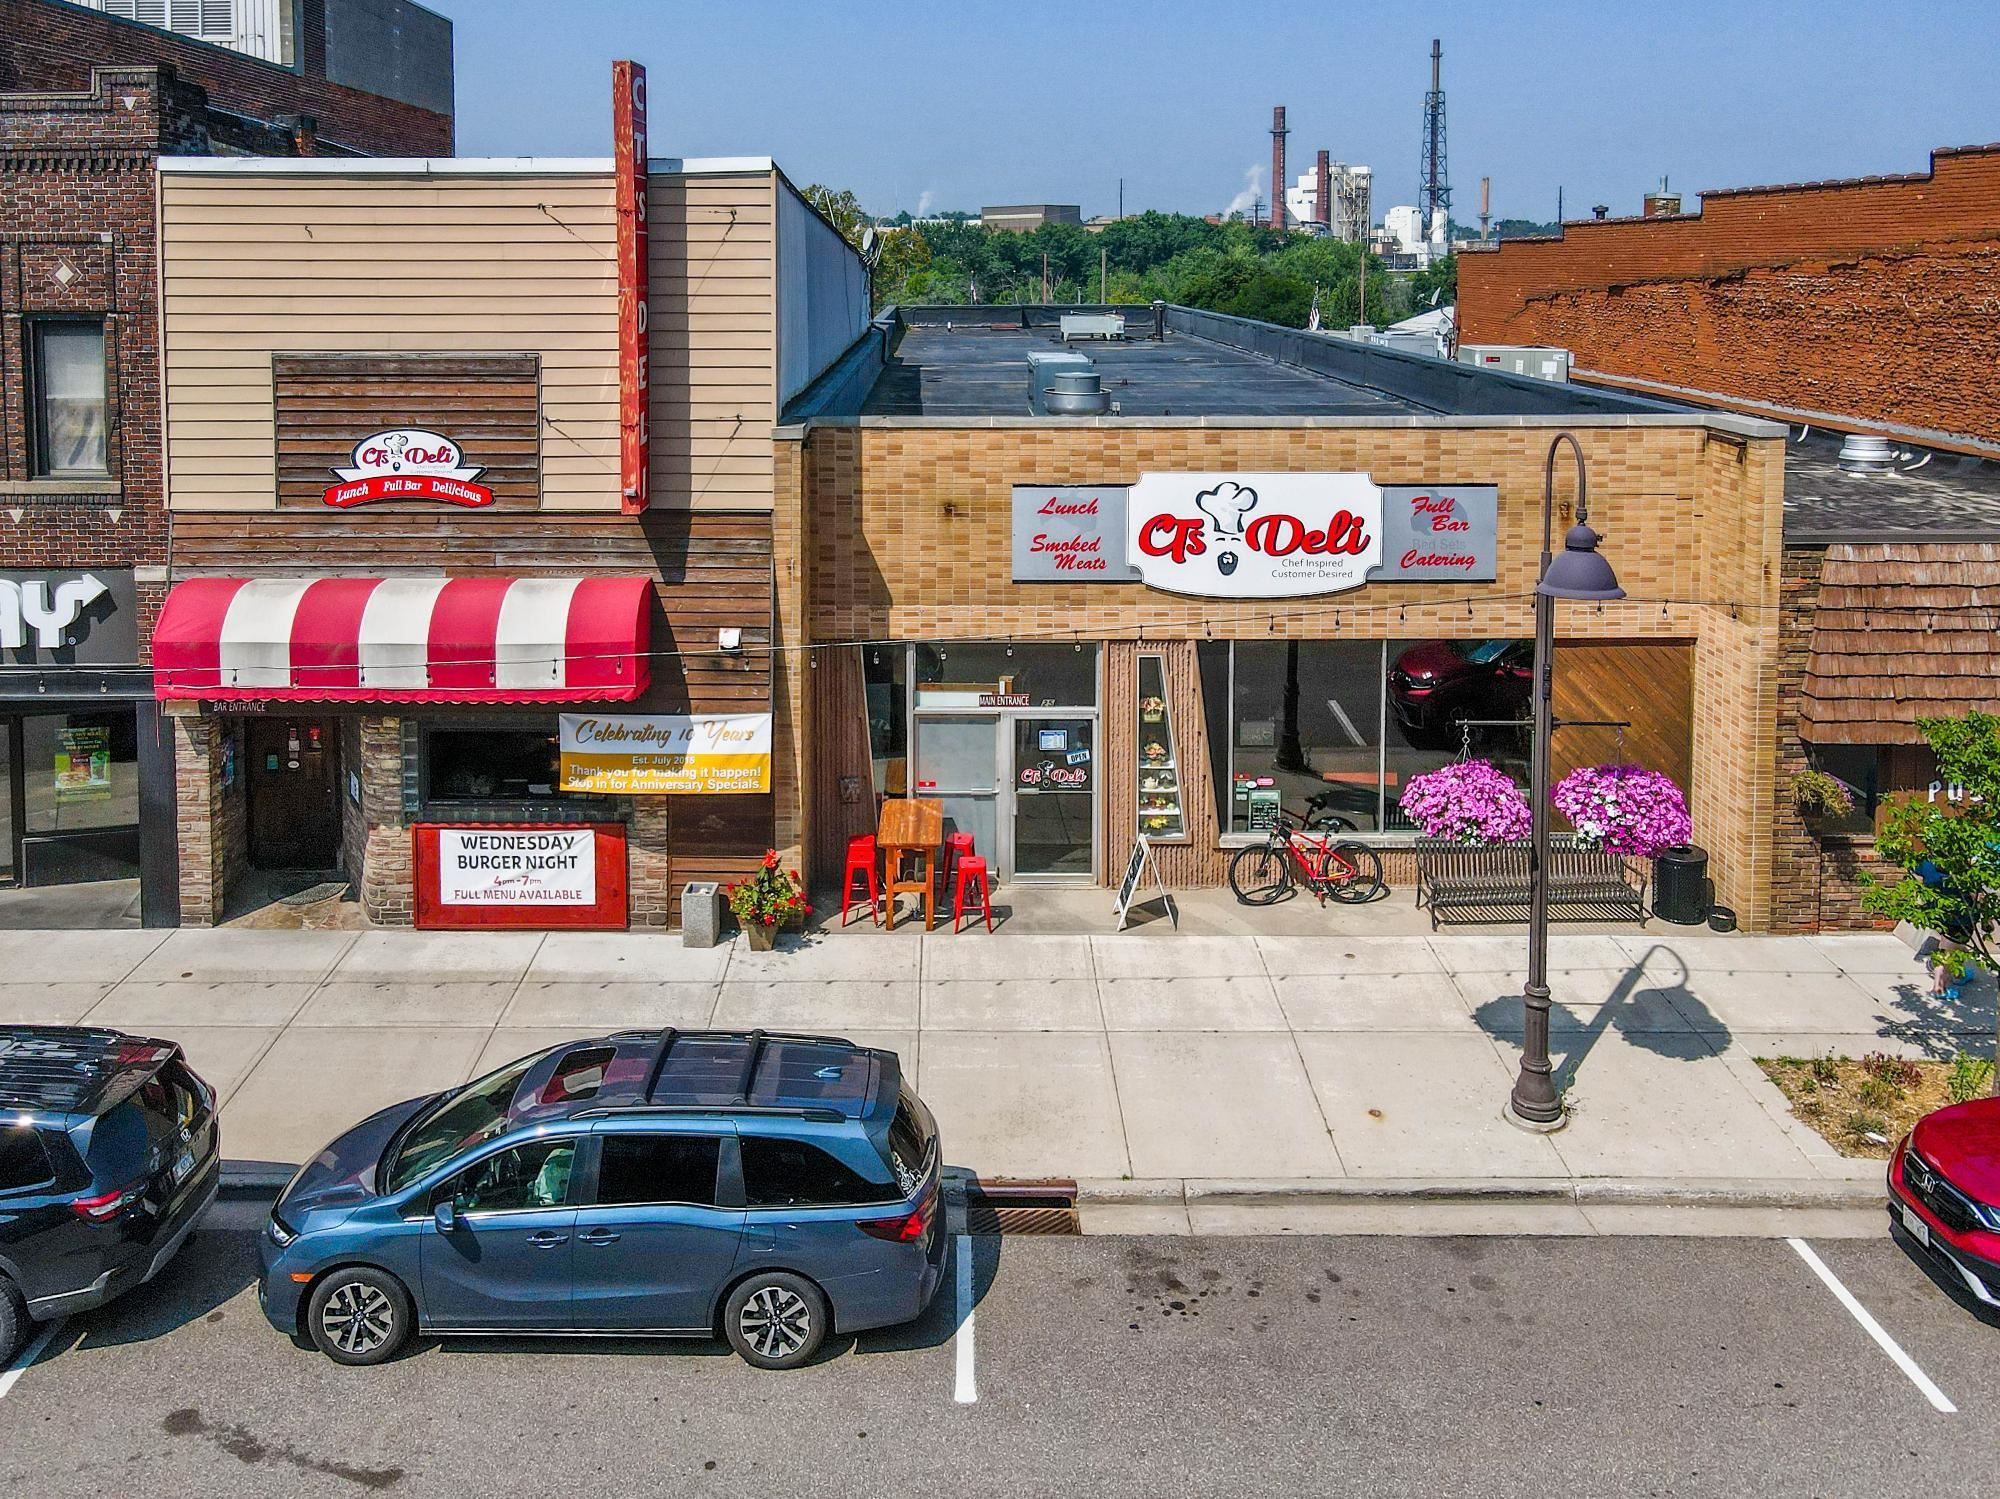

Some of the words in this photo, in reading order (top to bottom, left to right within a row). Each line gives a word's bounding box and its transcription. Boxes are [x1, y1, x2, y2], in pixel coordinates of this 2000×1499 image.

[637, 300, 648, 500] DELI
[404, 445, 454, 464] Deli
[336, 484, 369, 503] Lunch
[383, 480, 403, 492] Full
[404, 481, 423, 491] Bar
[1037, 496, 1099, 515] Lunch
[1410, 496, 1456, 516] Full
[1431, 514, 1471, 532] Bar
[1030, 533, 1102, 553] Smoked
[1138, 513, 1207, 564] CTs
[1245, 509, 1371, 557] Deli
[1053, 553, 1107, 571] Meats
[1281, 558, 1303, 568] Chef
[1306, 558, 1344, 569] Inspired
[1400, 549, 1477, 571] Catering
[1271, 569, 1316, 579] Customer
[1318, 569, 1353, 578] Desired
[213, 701, 227, 712] BAR
[228, 701, 266, 712] ENTRANCE
[980, 695, 996, 706] MAIN
[997, 695, 1030, 706] ENTRANCE
[575, 719, 672, 749] Celebrating
[703, 720, 755, 750] Years
[652, 755, 671, 767] July
[1071, 752, 1087, 763] OPEN
[569, 764, 603, 776] Thank
[607, 769, 629, 780] you
[632, 766, 649, 778] for
[653, 767, 697, 780] making
[701, 766, 709, 778] it
[711, 766, 761, 779] happen!
[1051, 768, 1087, 783] Deli
[568, 776, 593, 790] Stop
[596, 778, 607, 789] in
[610, 778, 628, 789] for
[631, 779, 704, 791] Anniversary
[707, 777, 762, 790] Specials.
[1927, 780, 1984, 804] PU
[461, 836, 575, 850] WEDNESDAY
[457, 855, 522, 870] BURGER
[526, 855, 578, 870] NIGHT
[454, 890, 480, 900] FULL
[483, 890, 516, 900] MENU
[519, 889, 582, 900] AVAILABLE
